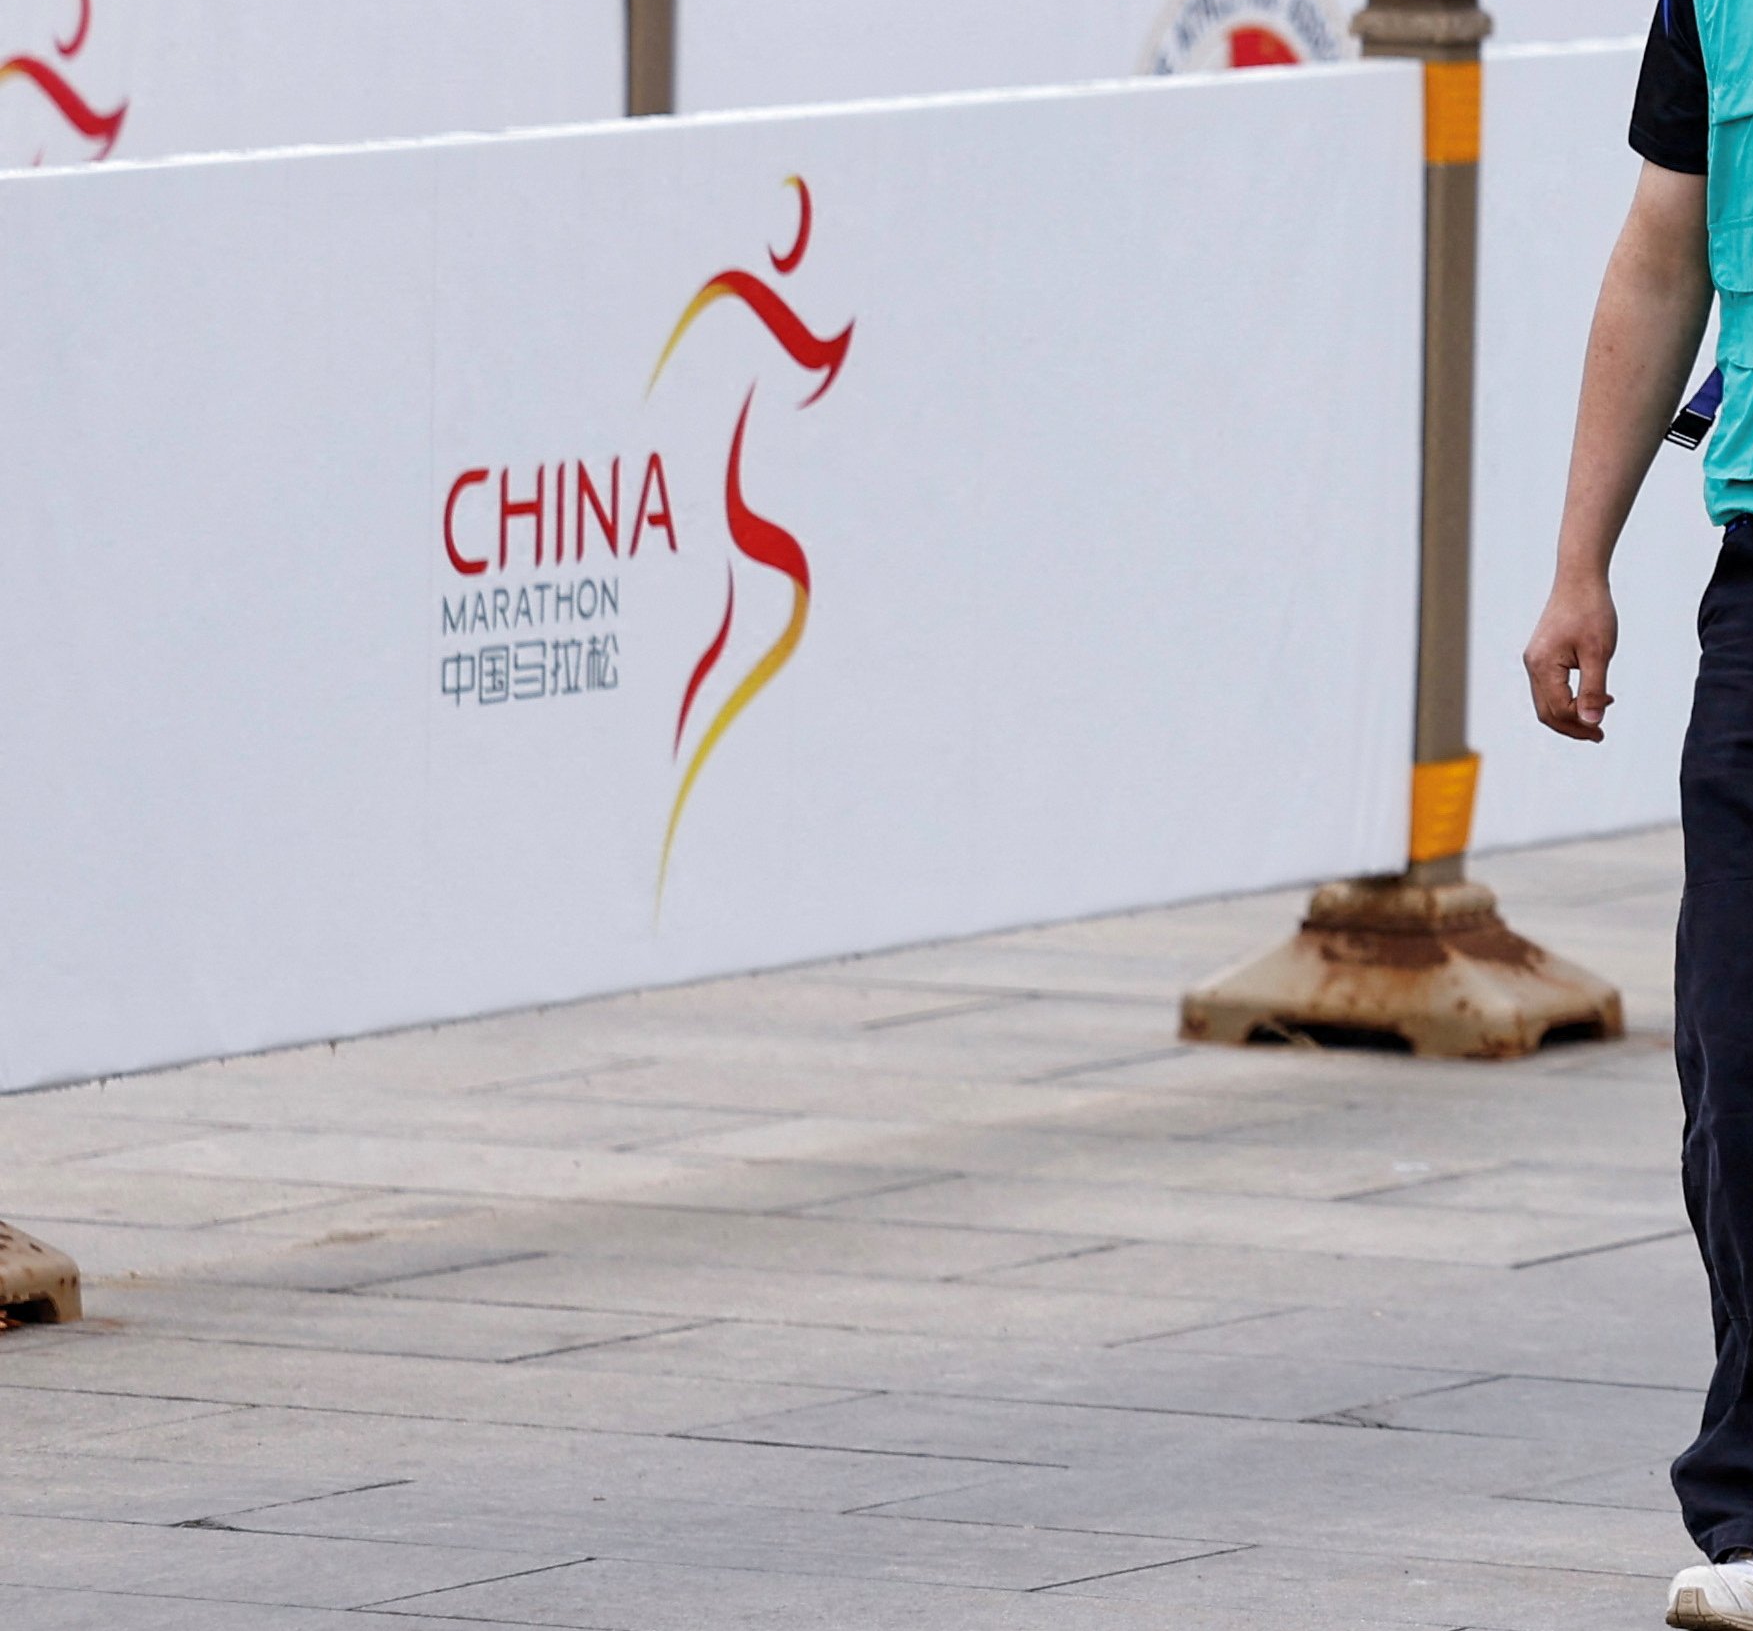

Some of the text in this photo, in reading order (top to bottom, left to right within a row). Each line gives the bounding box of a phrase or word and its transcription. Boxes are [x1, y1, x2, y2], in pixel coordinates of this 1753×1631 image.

[443, 451, 678, 576] CHINA
[442, 577, 620, 636] MARATHON
[442, 633, 620, 707] 中国马拉松
